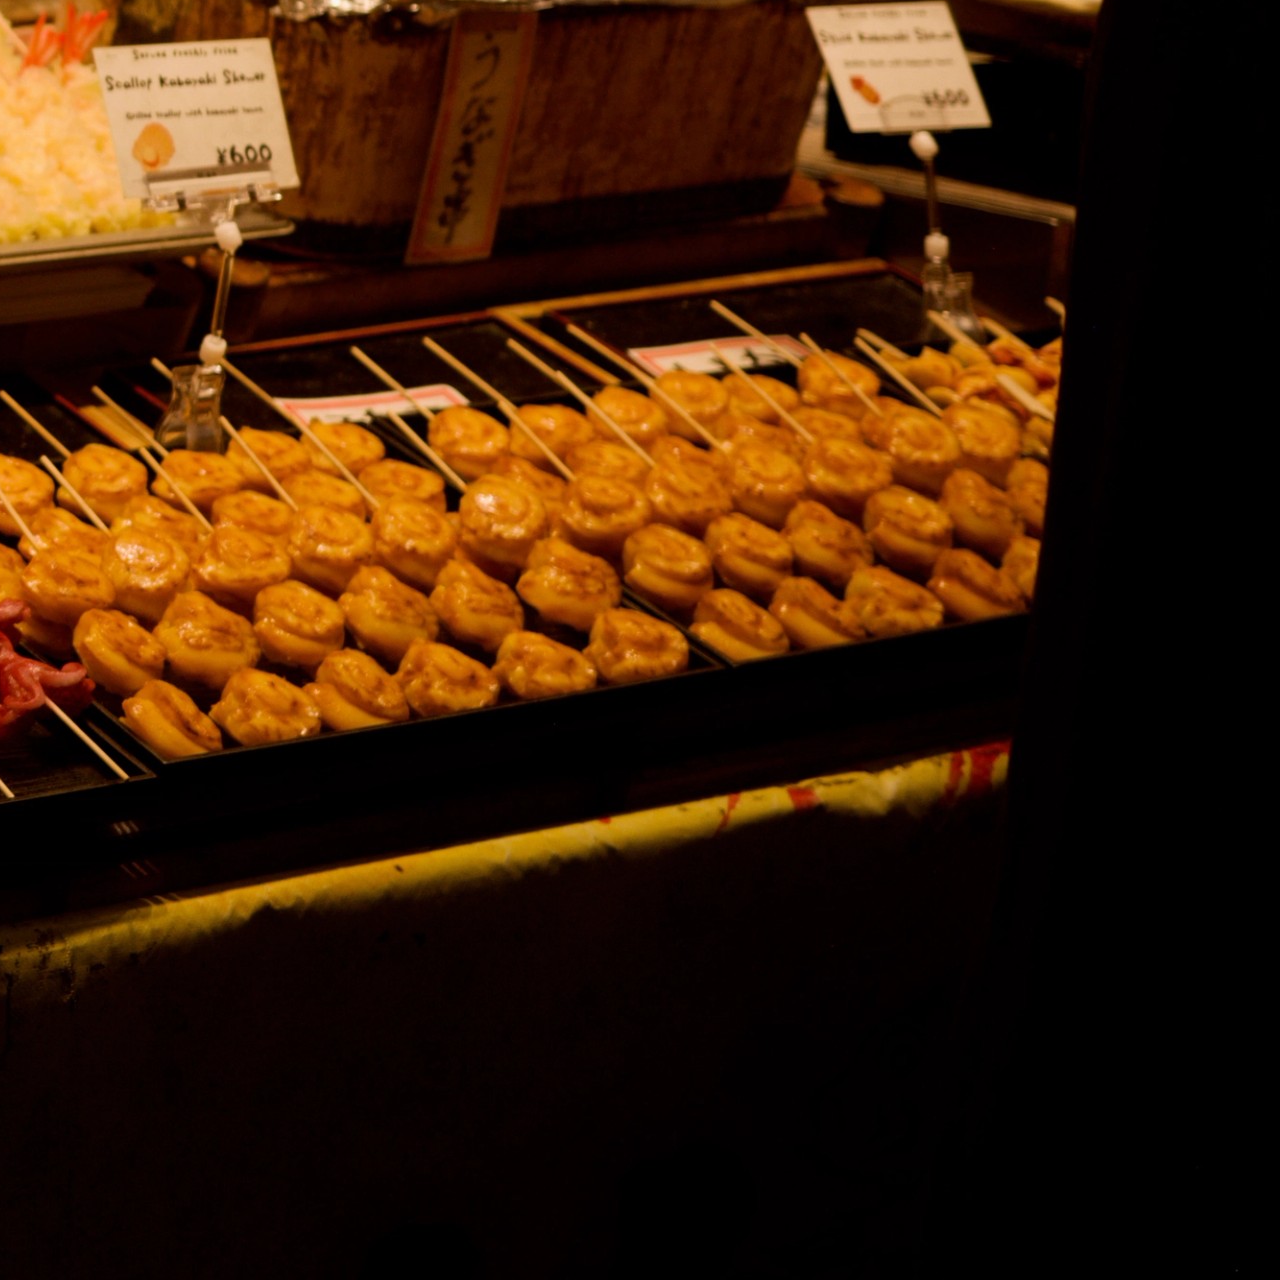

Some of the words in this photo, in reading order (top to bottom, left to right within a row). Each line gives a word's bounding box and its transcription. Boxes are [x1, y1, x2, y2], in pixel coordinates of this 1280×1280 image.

[105, 74, 153, 91] Scallop
[159, 72, 217, 89] Kabayaki
[223, 68, 265, 86] Skewer
[216, 143, 273, 166] ¥600
